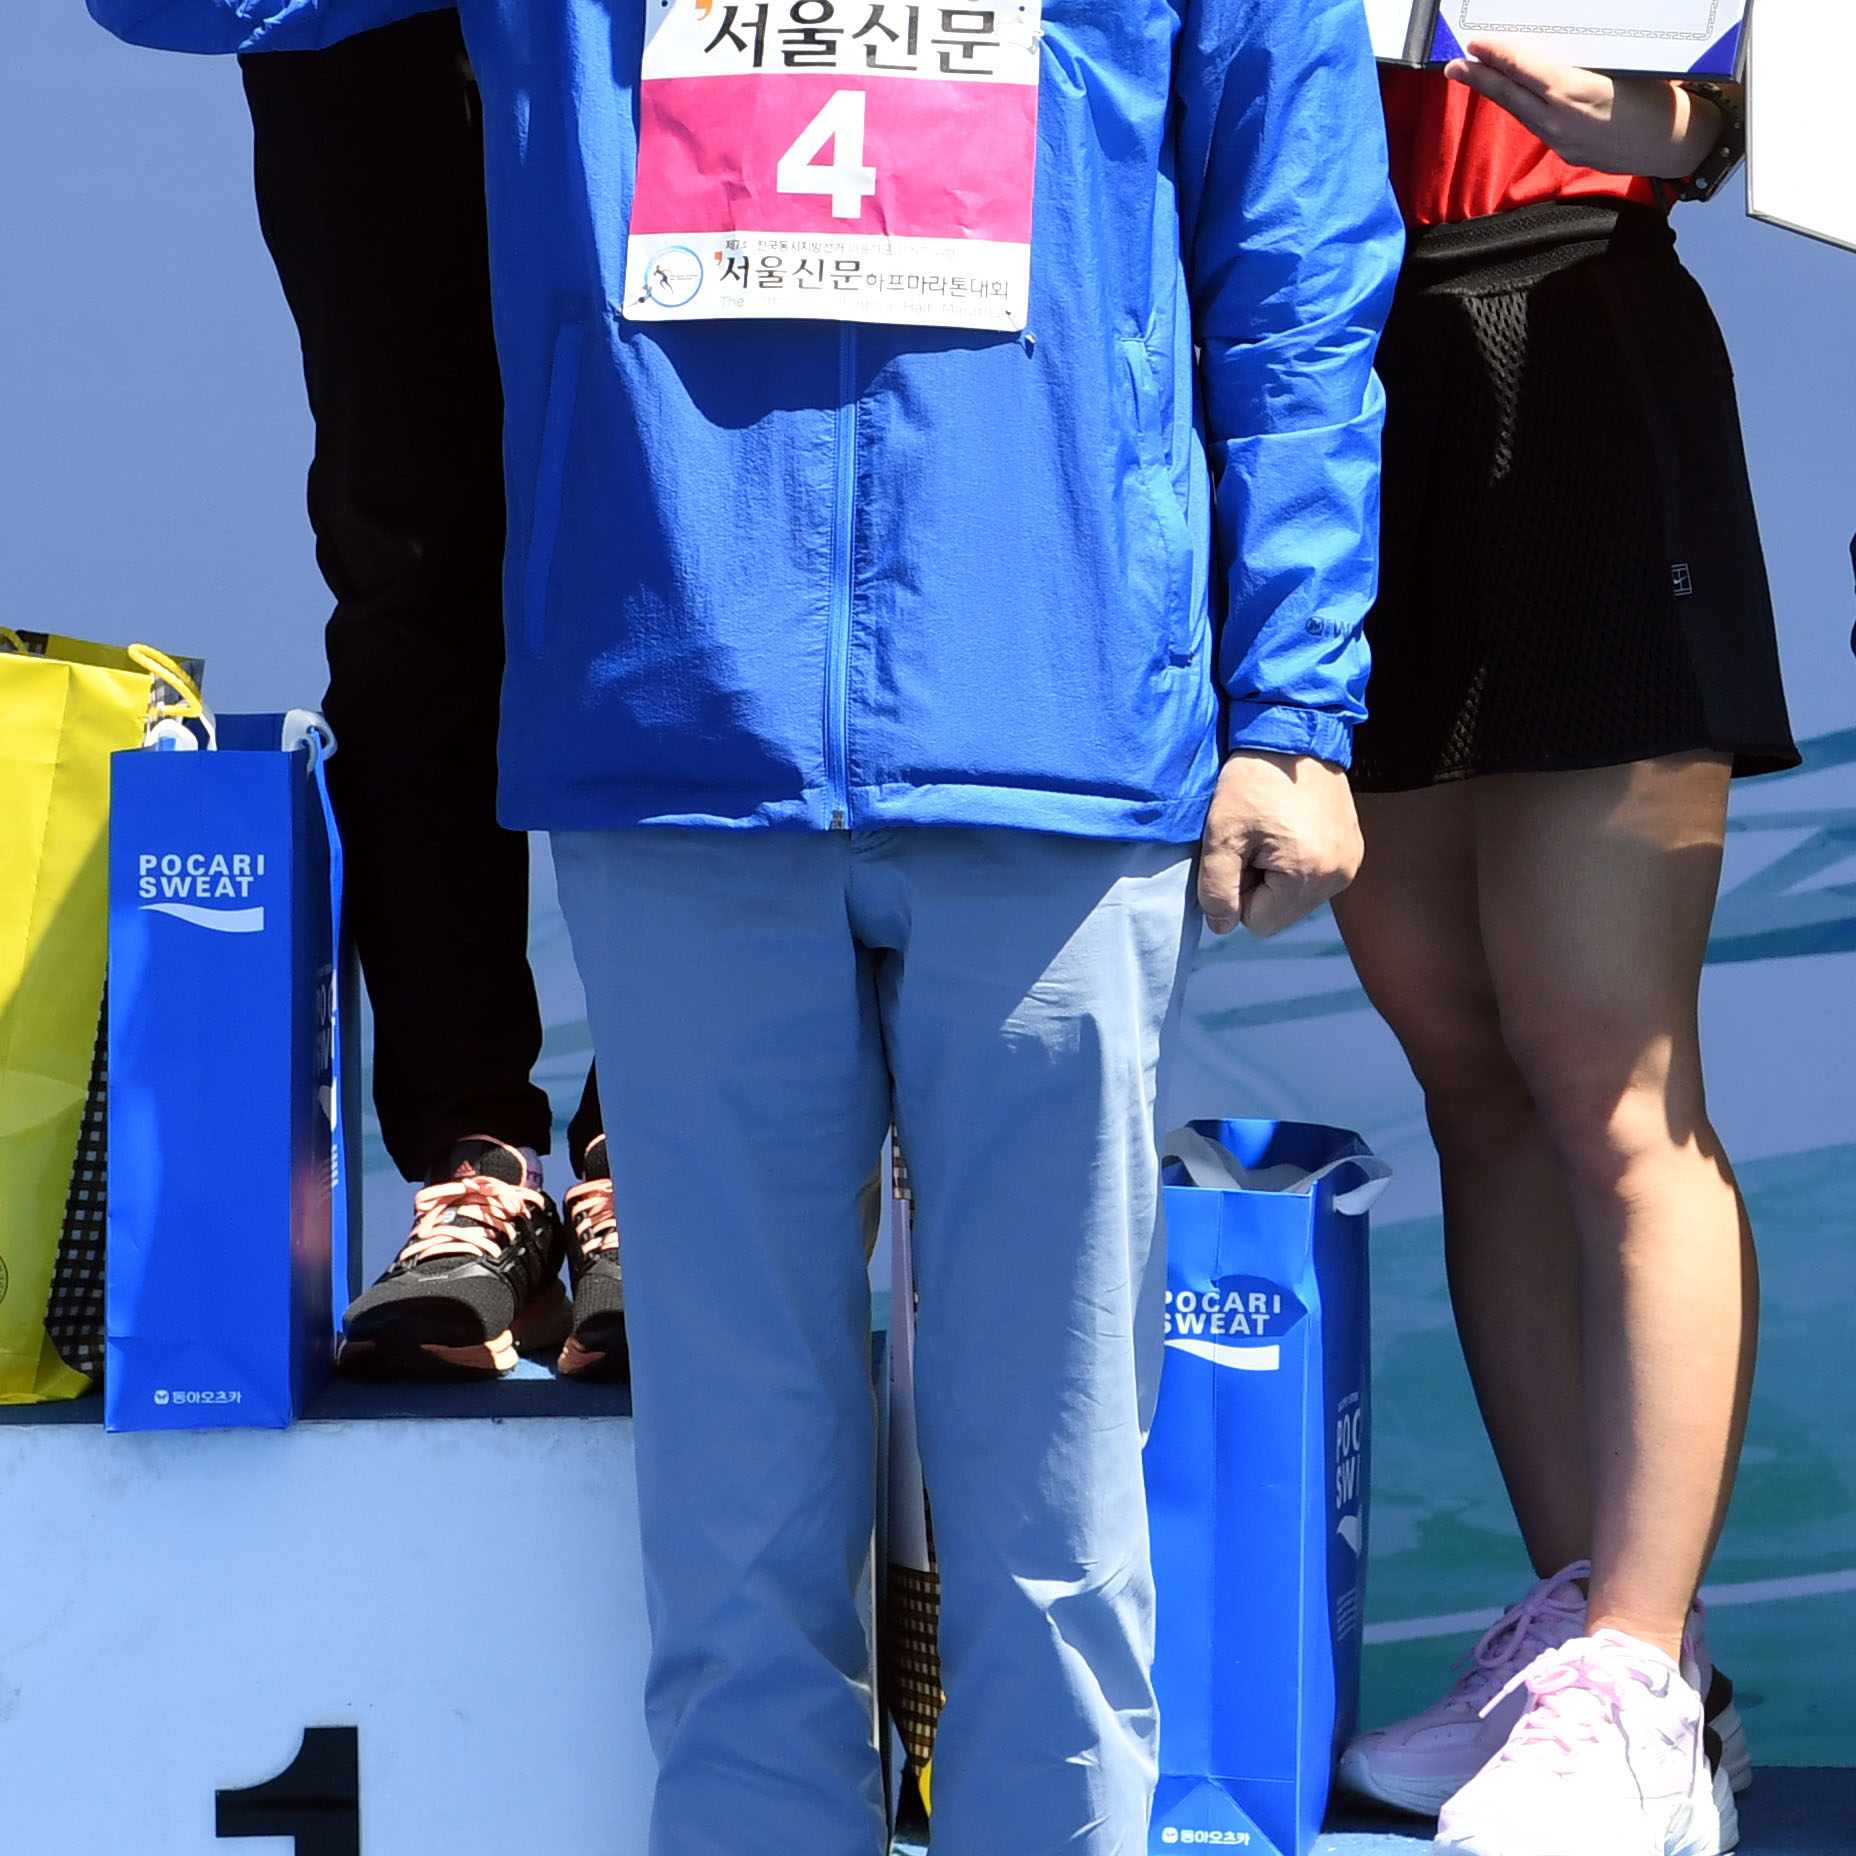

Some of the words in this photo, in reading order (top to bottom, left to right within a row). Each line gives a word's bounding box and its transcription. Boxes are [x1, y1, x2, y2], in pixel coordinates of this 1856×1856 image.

[776, 89, 877, 219] 4
[719, 255, 864, 291] 서울신문
[865, 272, 1009, 302] 하프마라톤대회
[139, 854, 265, 876] POCARI
[138, 876, 254, 898] SWEAT
[172, 1390, 242, 1404] 동아오츠카
[215, 1726, 360, 1856] 1
[1180, 1828, 1251, 1846] 동아오츠카
